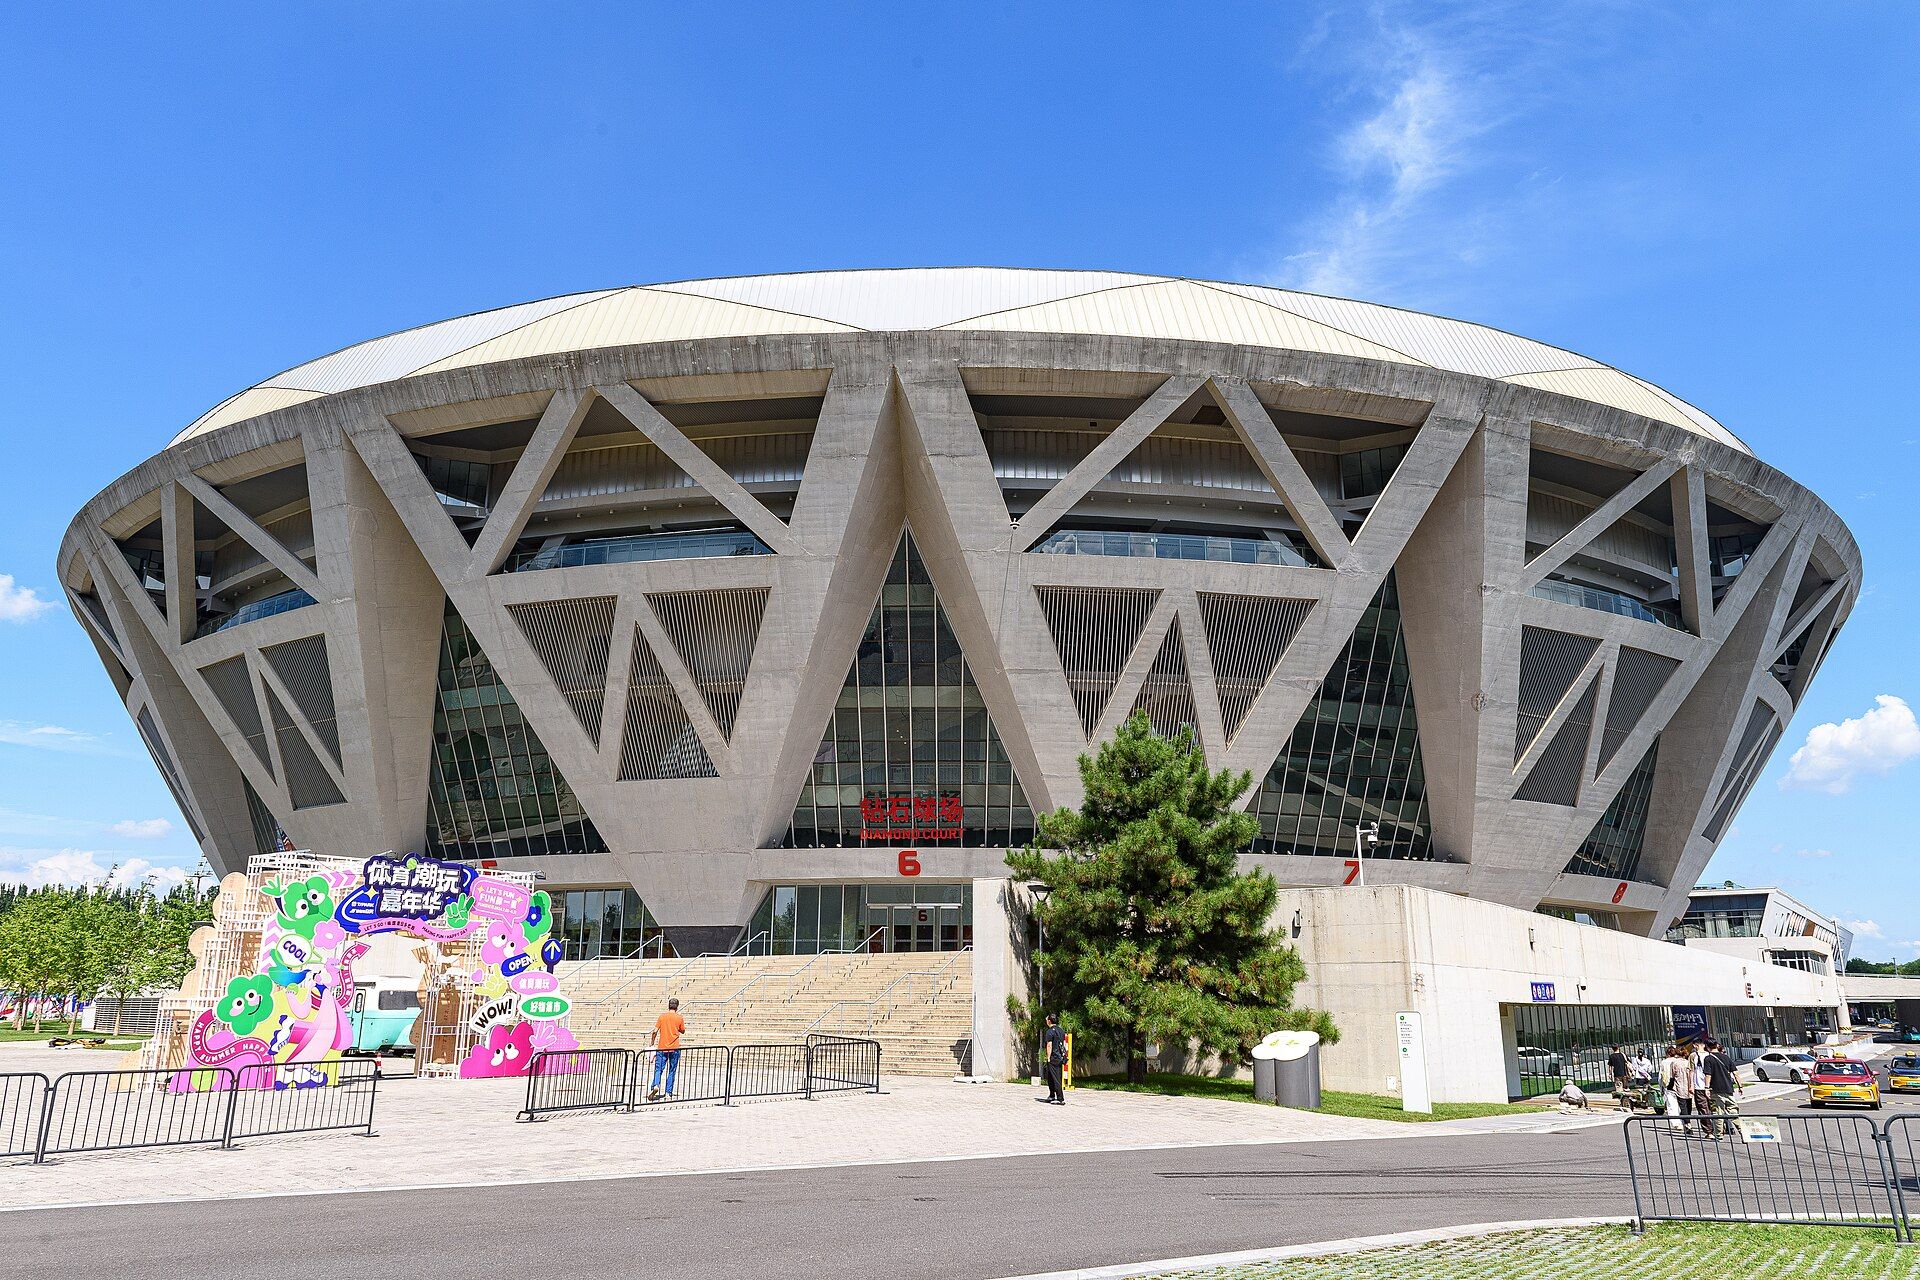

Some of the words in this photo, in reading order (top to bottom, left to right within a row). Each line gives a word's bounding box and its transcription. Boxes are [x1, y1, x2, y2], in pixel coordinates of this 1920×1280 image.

[860, 796, 964, 823] 钻石球场
[861, 828, 920, 839] DIAMOND
[922, 828, 964, 839] COURT
[898, 850, 921, 876] 6
[1343, 860, 1361, 885] 7
[367, 859, 460, 893] 体育潮玩
[380, 888, 442, 914] 嘉年华
[503, 890, 515, 899] FUN
[1611, 882, 1628, 904] 8
[918, 909, 928, 921] 6
[283, 940, 307, 963] COOL
[475, 999, 512, 1029] WOW!
[193, 1021, 204, 1052] HAPPY
[200, 1047, 236, 1062] SUMMER
